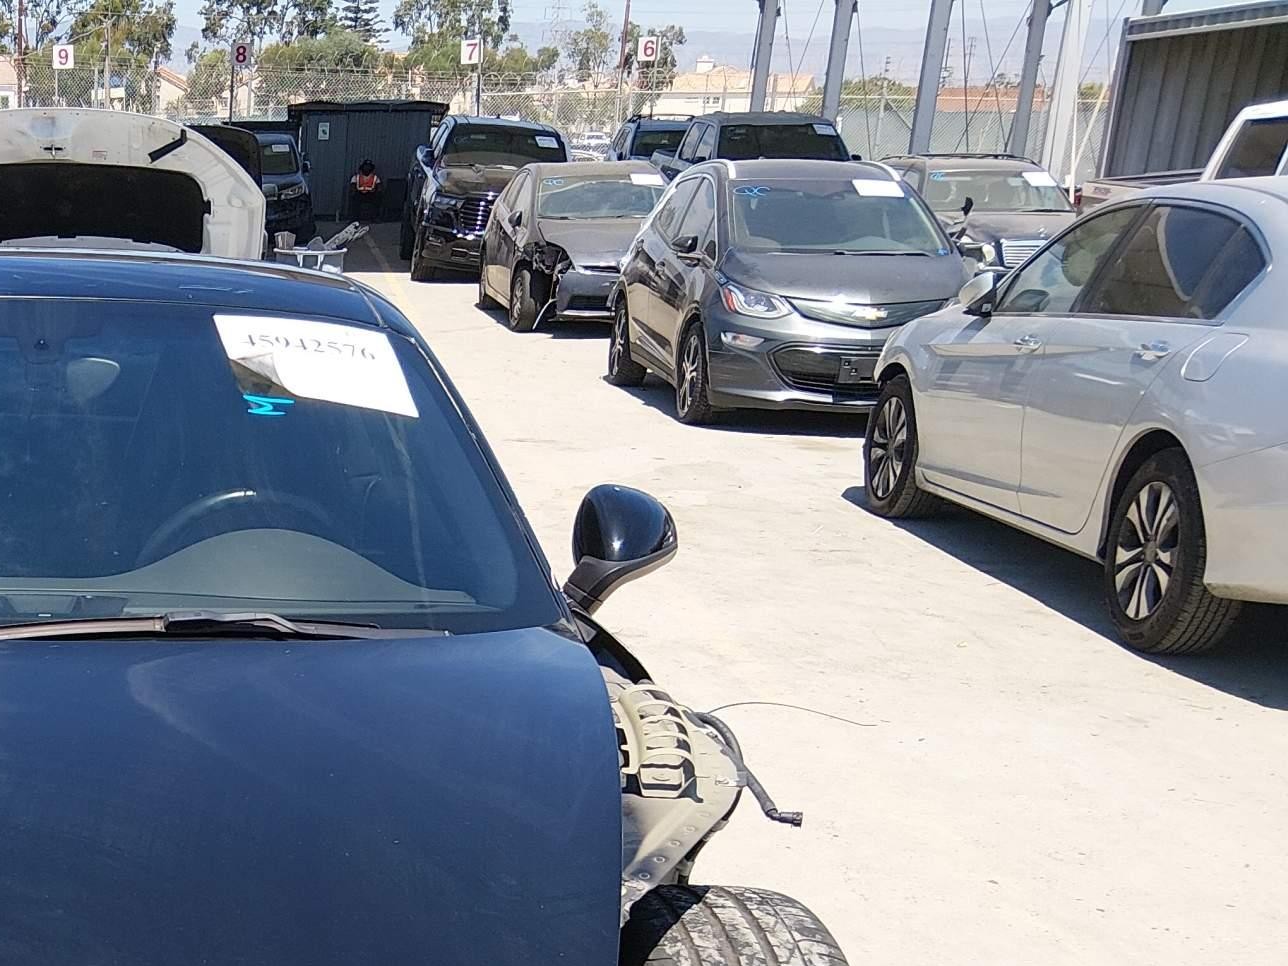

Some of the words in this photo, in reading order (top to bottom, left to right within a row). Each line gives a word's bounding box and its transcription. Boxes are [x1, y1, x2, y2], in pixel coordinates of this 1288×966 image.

[58, 48, 69, 66] 9
[235, 45, 247, 63] 8
[466, 42, 478, 61] 7
[643, 40, 655, 57] 6
